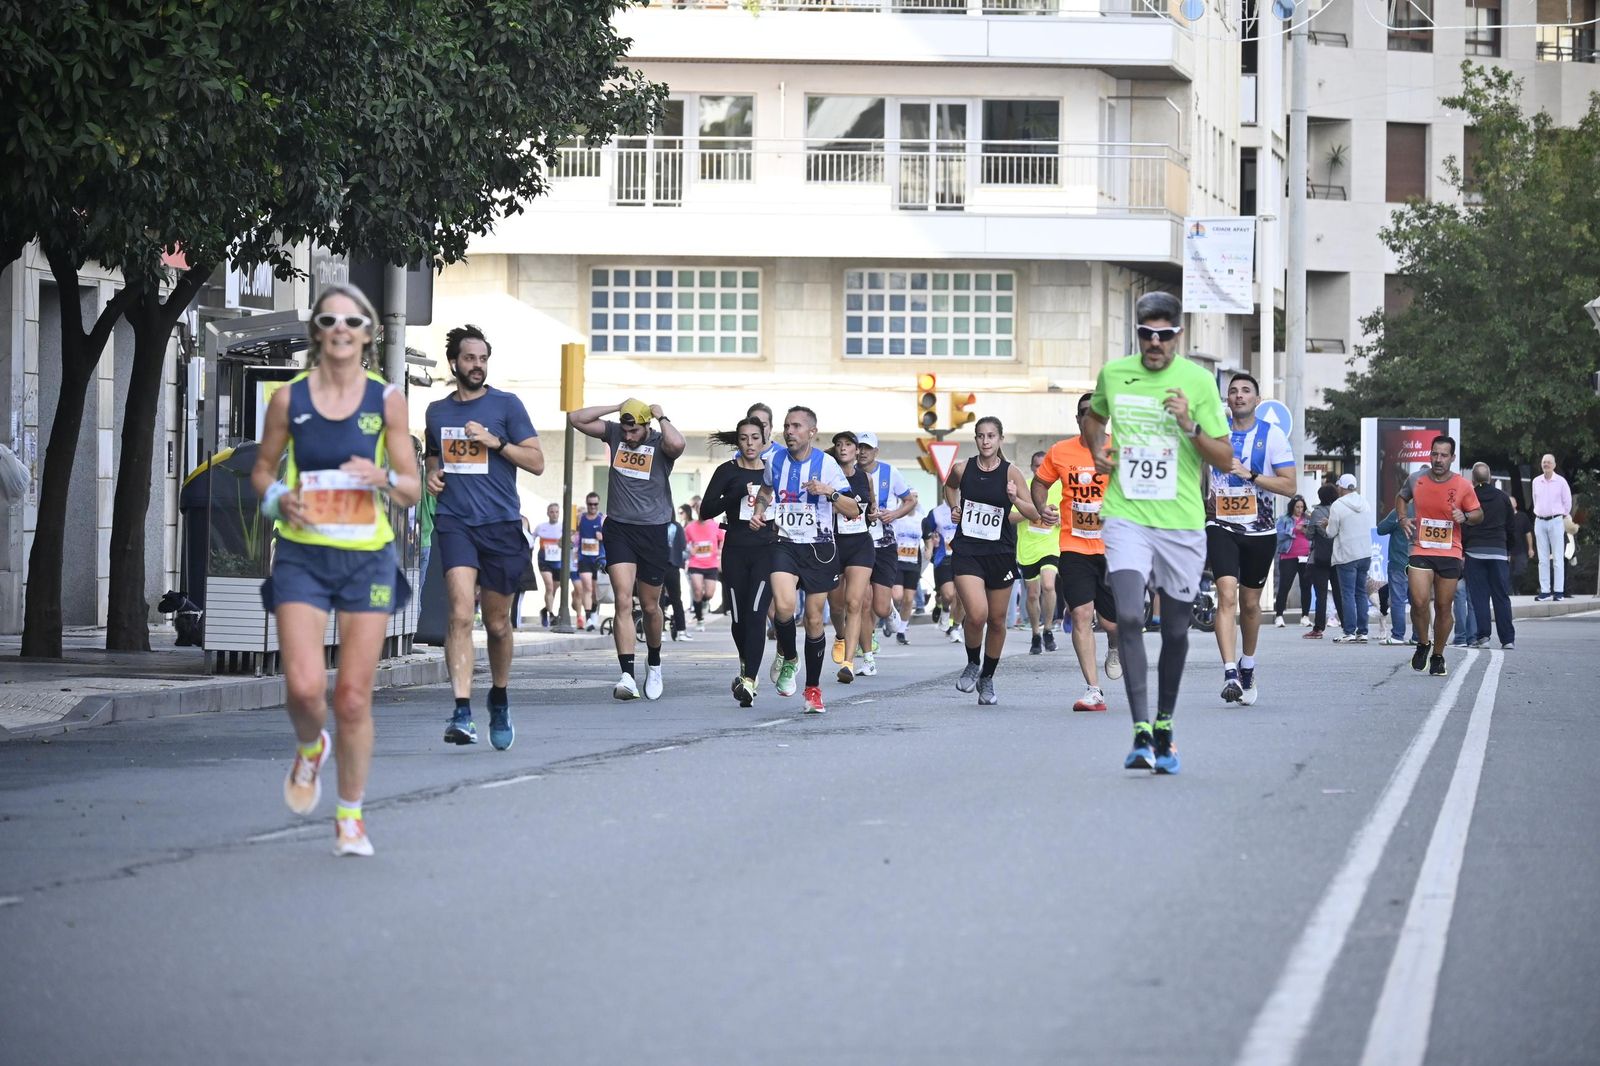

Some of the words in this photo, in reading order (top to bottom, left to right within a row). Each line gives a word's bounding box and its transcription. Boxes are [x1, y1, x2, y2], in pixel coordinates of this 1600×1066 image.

[448, 439, 480, 457] 435
[1402, 439, 1414, 449] Sed
[1414, 439, 1423, 449] de
[621, 451, 646, 467] 366
[1128, 460, 1167, 479] 795
[1070, 486, 1103, 498] TUR
[1222, 496, 1250, 510] 352
[778, 513, 814, 527] 1073
[966, 510, 1000, 527] 1106
[1425, 527, 1447, 539] 563
